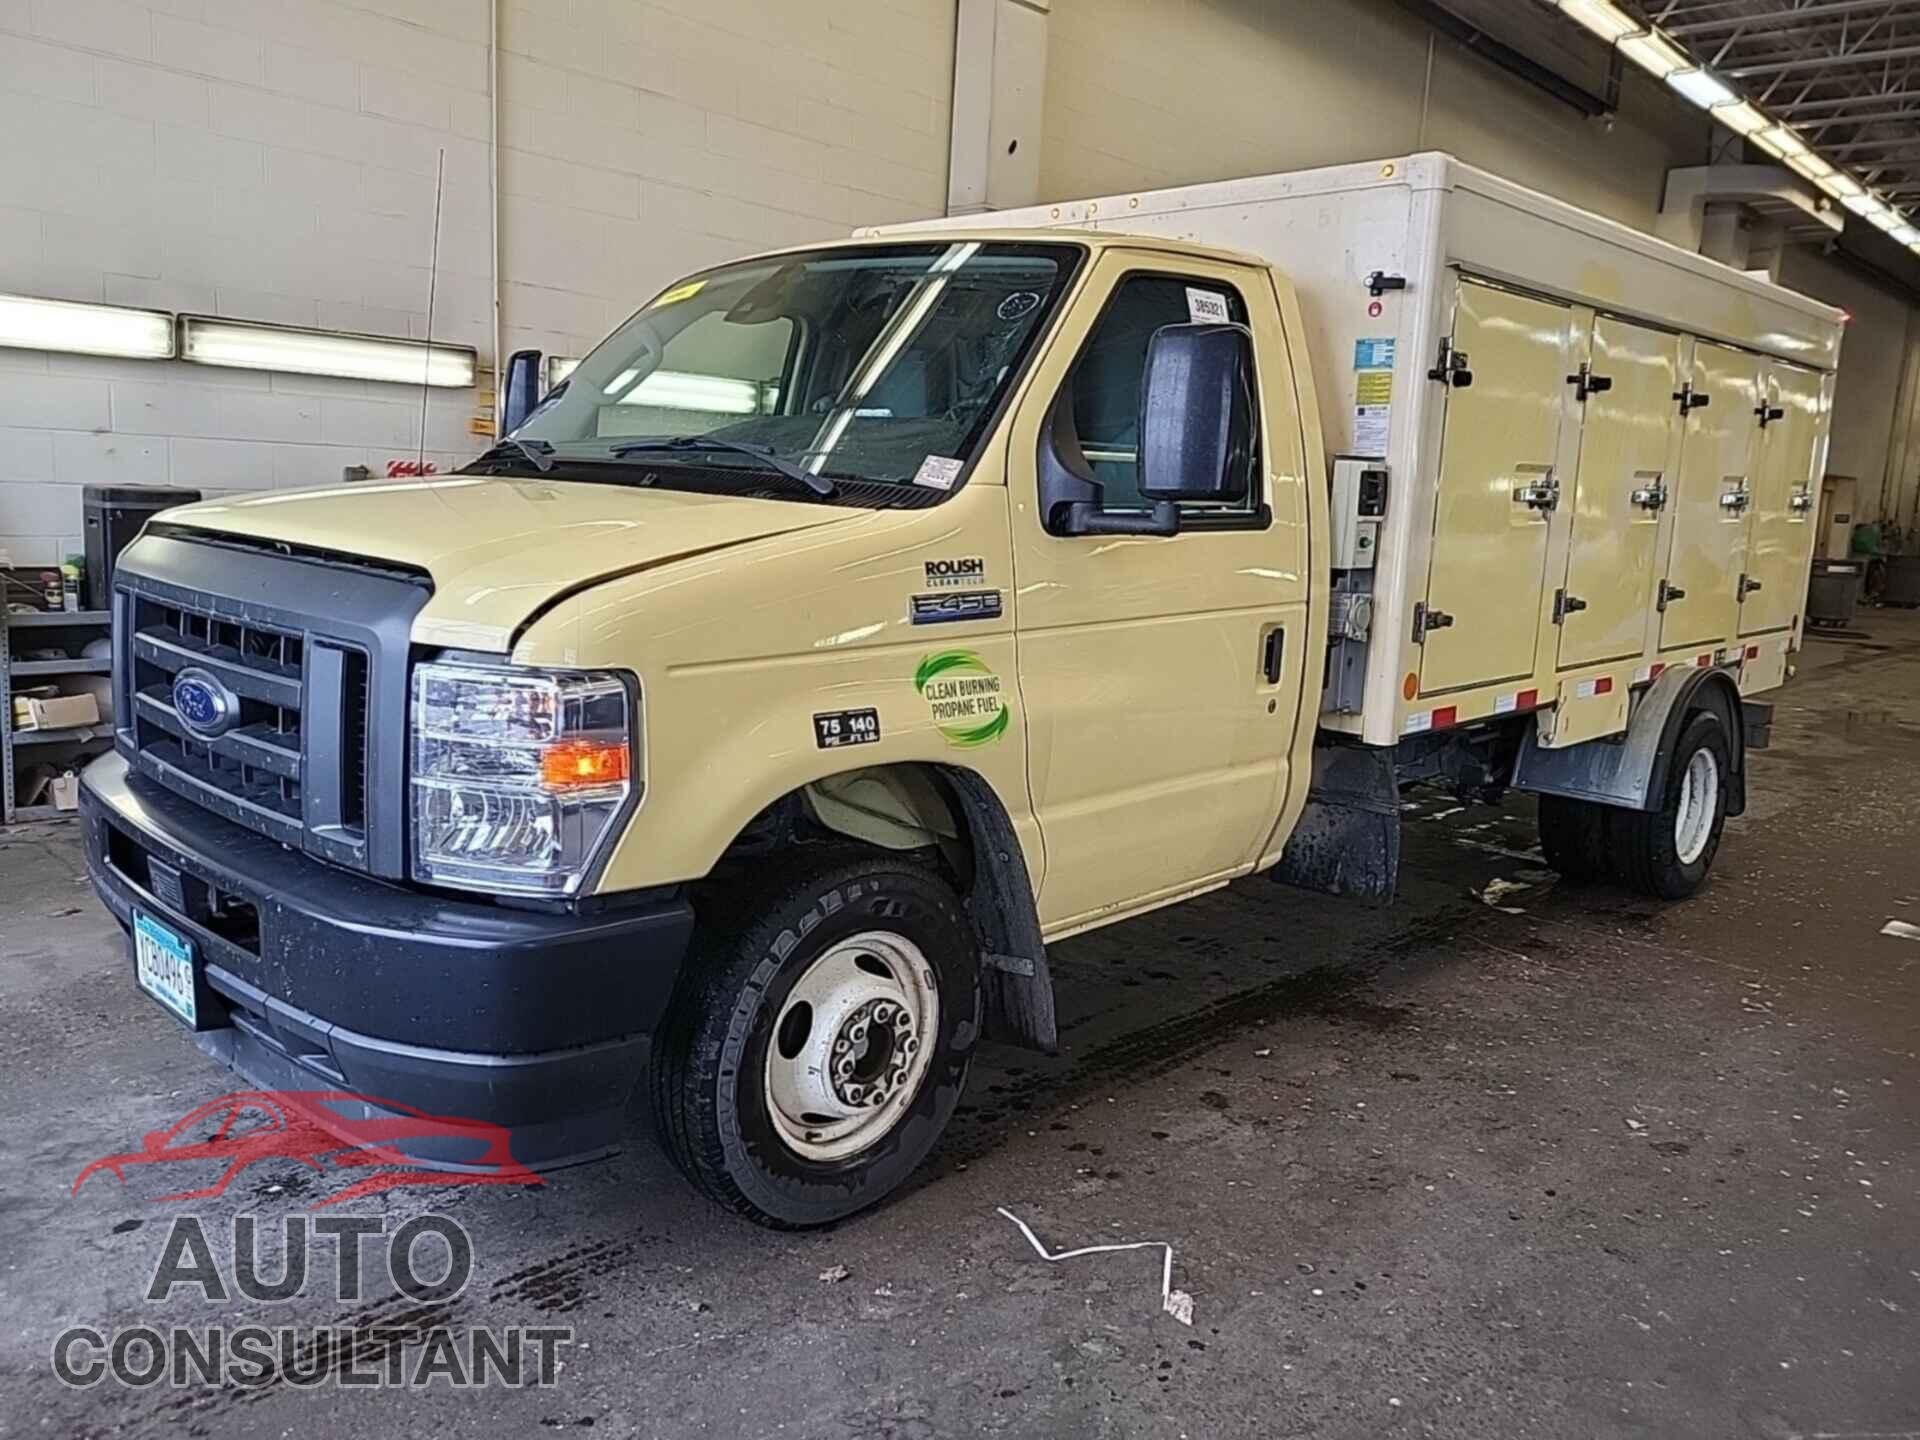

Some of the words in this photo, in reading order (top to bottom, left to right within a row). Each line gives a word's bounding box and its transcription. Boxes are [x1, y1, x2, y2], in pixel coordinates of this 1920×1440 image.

[925, 559, 983, 575] ROUSH
[926, 682, 957, 700] CLEAN
[959, 676, 999, 696] BURNING
[932, 698, 975, 719] PROPANE
[977, 696, 1000, 713] FUEL
[820, 719, 841, 735] 75
[848, 716, 875, 732] 140
